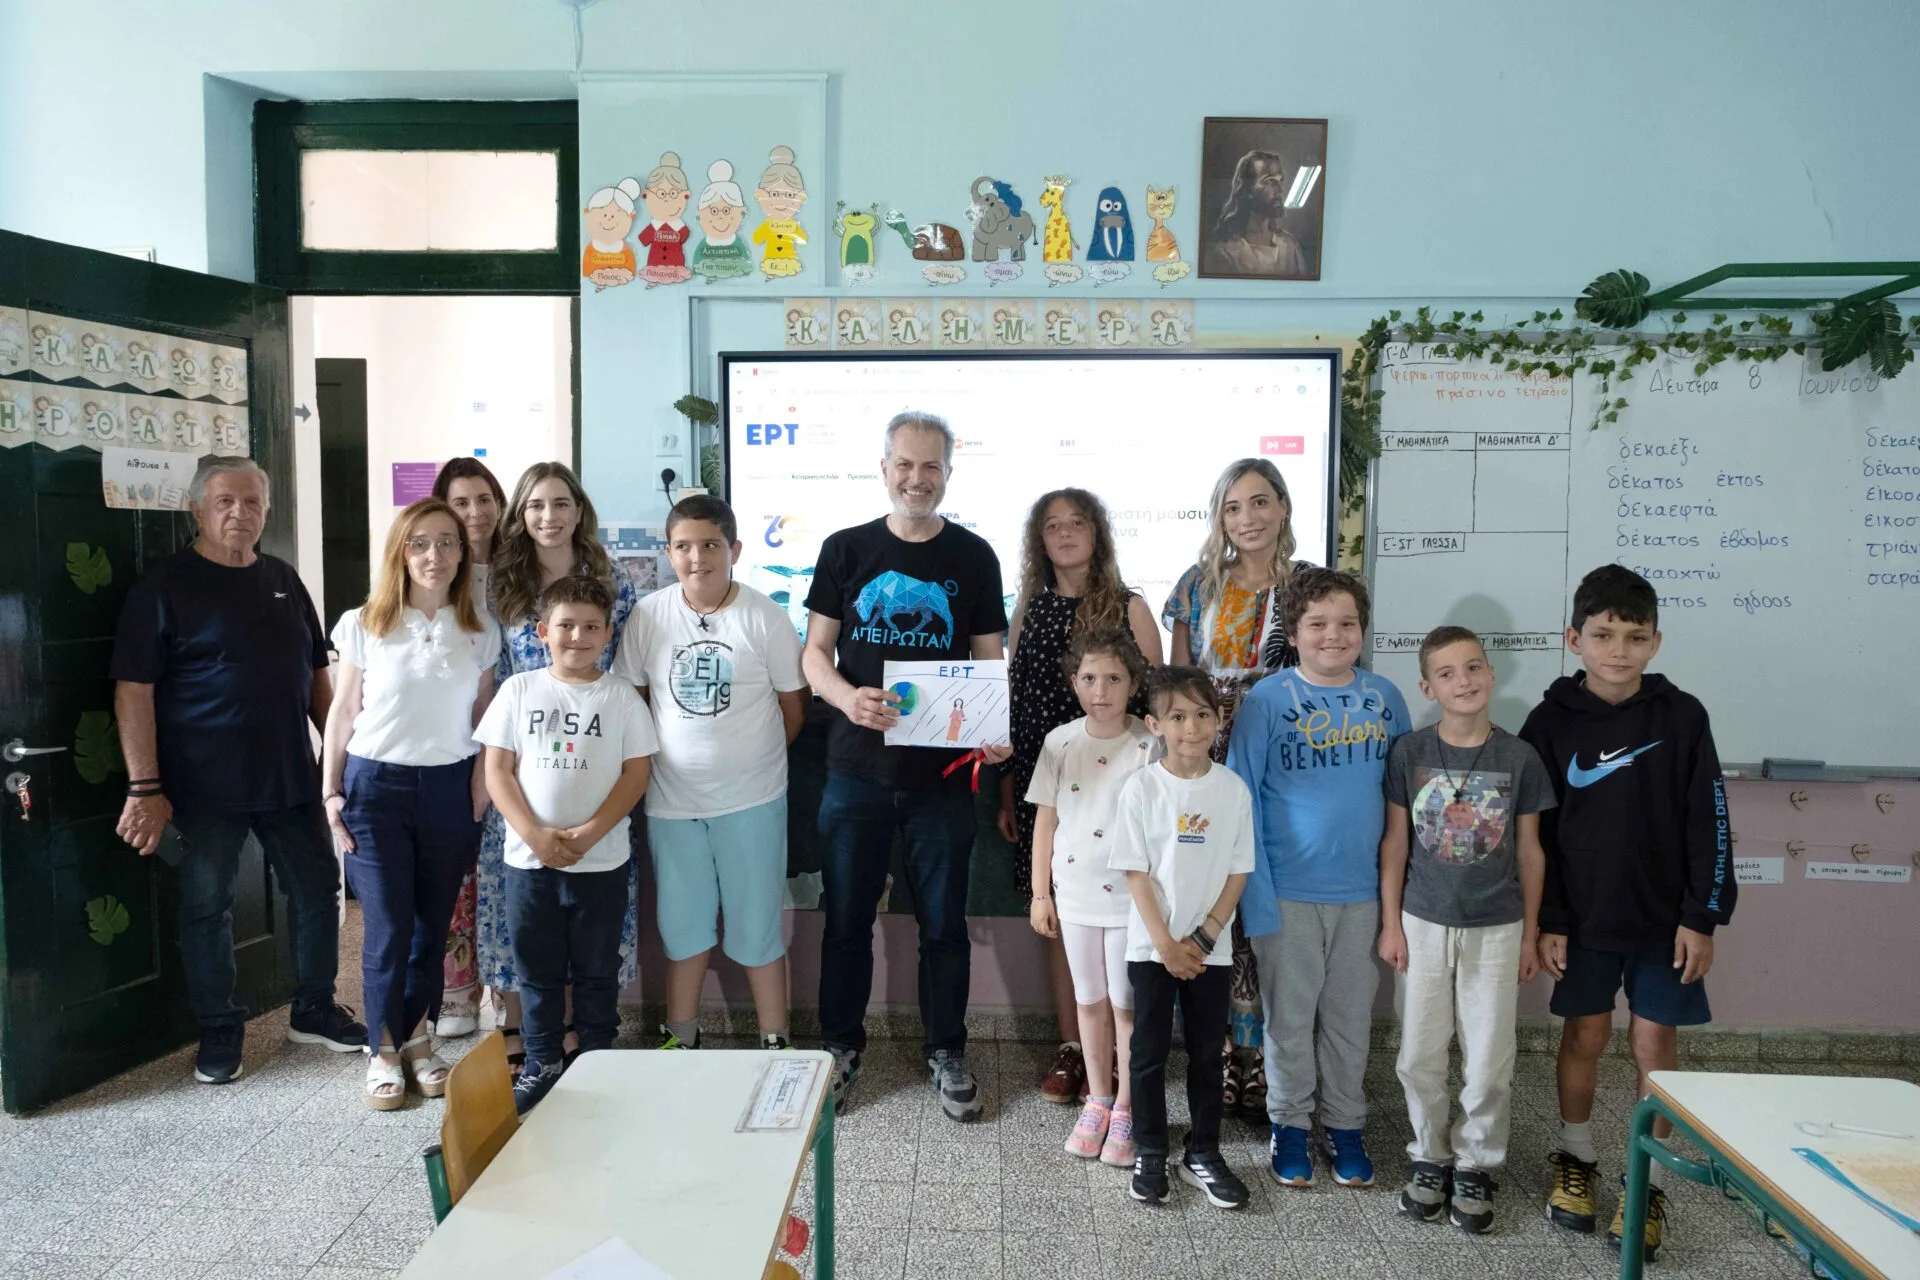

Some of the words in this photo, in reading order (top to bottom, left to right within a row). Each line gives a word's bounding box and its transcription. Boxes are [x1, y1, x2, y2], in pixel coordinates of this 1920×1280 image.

[1749, 364, 1762, 390] 8
[746, 423, 799, 445] ΕΡΤ
[1397, 435, 1449, 448] ΜΑΘΗΜΑΤΙΚΑ
[1478, 435, 1541, 446] ΜΑΘΗΜΑΤΙΚΑ
[1618, 435, 1699, 467] δεκαέξι
[1607, 465, 1684, 490] δέκατος
[1716, 469, 1764, 488] έκτος
[1107, 506, 1152, 523] ριστή
[1616, 493, 1718, 522] δεκαεφτά
[1616, 523, 1700, 547] δέκατος
[1656, 595, 1707, 608] ατος
[704, 646, 720, 657] OF
[1492, 636, 1548, 649] ΜΑΘΗΜΑΤΙΚΑ
[938, 666, 975, 679] ΕΡΤ
[1282, 694, 1393, 723] UNITED
[1287, 731, 1299, 743] OF
[1296, 710, 1388, 750] Colors
[535, 757, 589, 770] ITALIA
[1712, 777, 1728, 816] DEPT.
[1714, 818, 1728, 885] ATHLETIC
